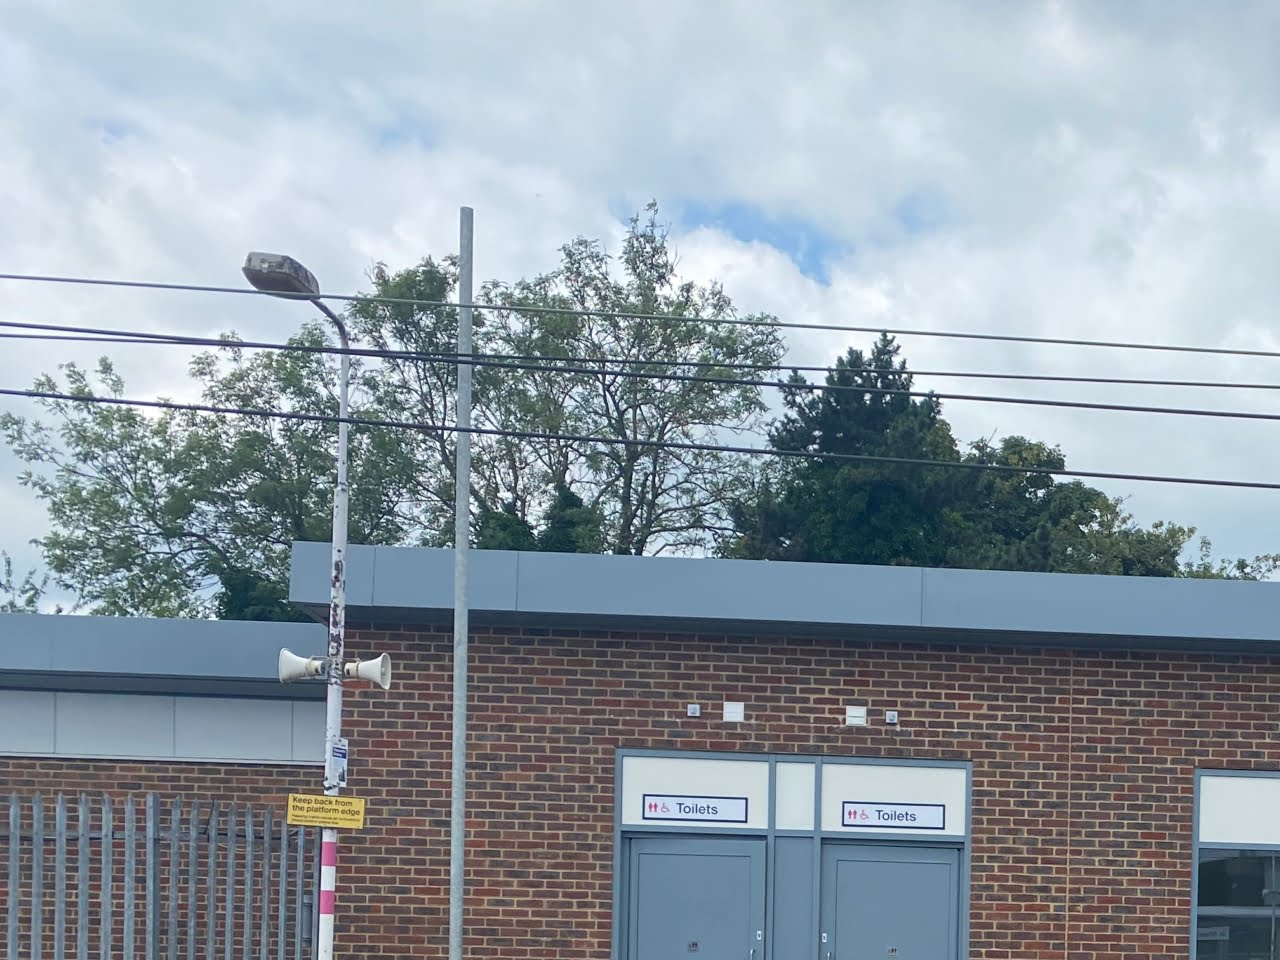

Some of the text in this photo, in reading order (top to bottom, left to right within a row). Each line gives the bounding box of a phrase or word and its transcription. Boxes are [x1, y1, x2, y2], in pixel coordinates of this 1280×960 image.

[306, 806, 339, 814] platform
[340, 808, 360, 816] edge
[676, 802, 718, 815] Toilets
[875, 809, 917, 822] Toilets
